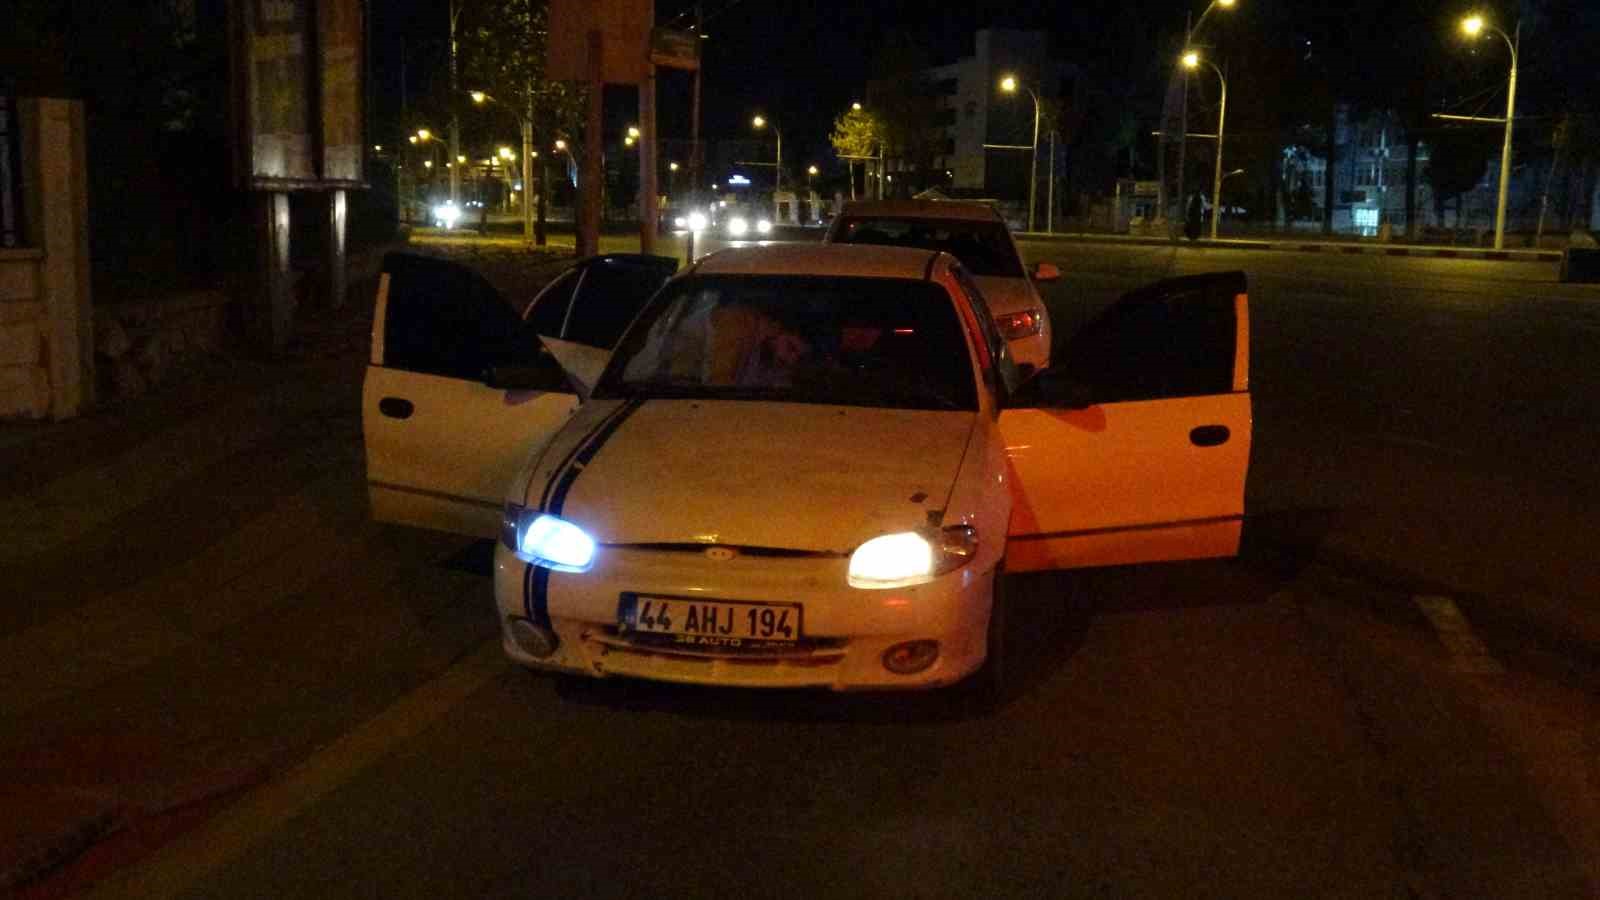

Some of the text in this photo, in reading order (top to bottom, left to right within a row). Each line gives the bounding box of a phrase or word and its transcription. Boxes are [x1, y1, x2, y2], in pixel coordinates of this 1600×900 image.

[639, 601, 793, 638] 44 AHJ 194
[698, 636, 742, 647] AUTO
